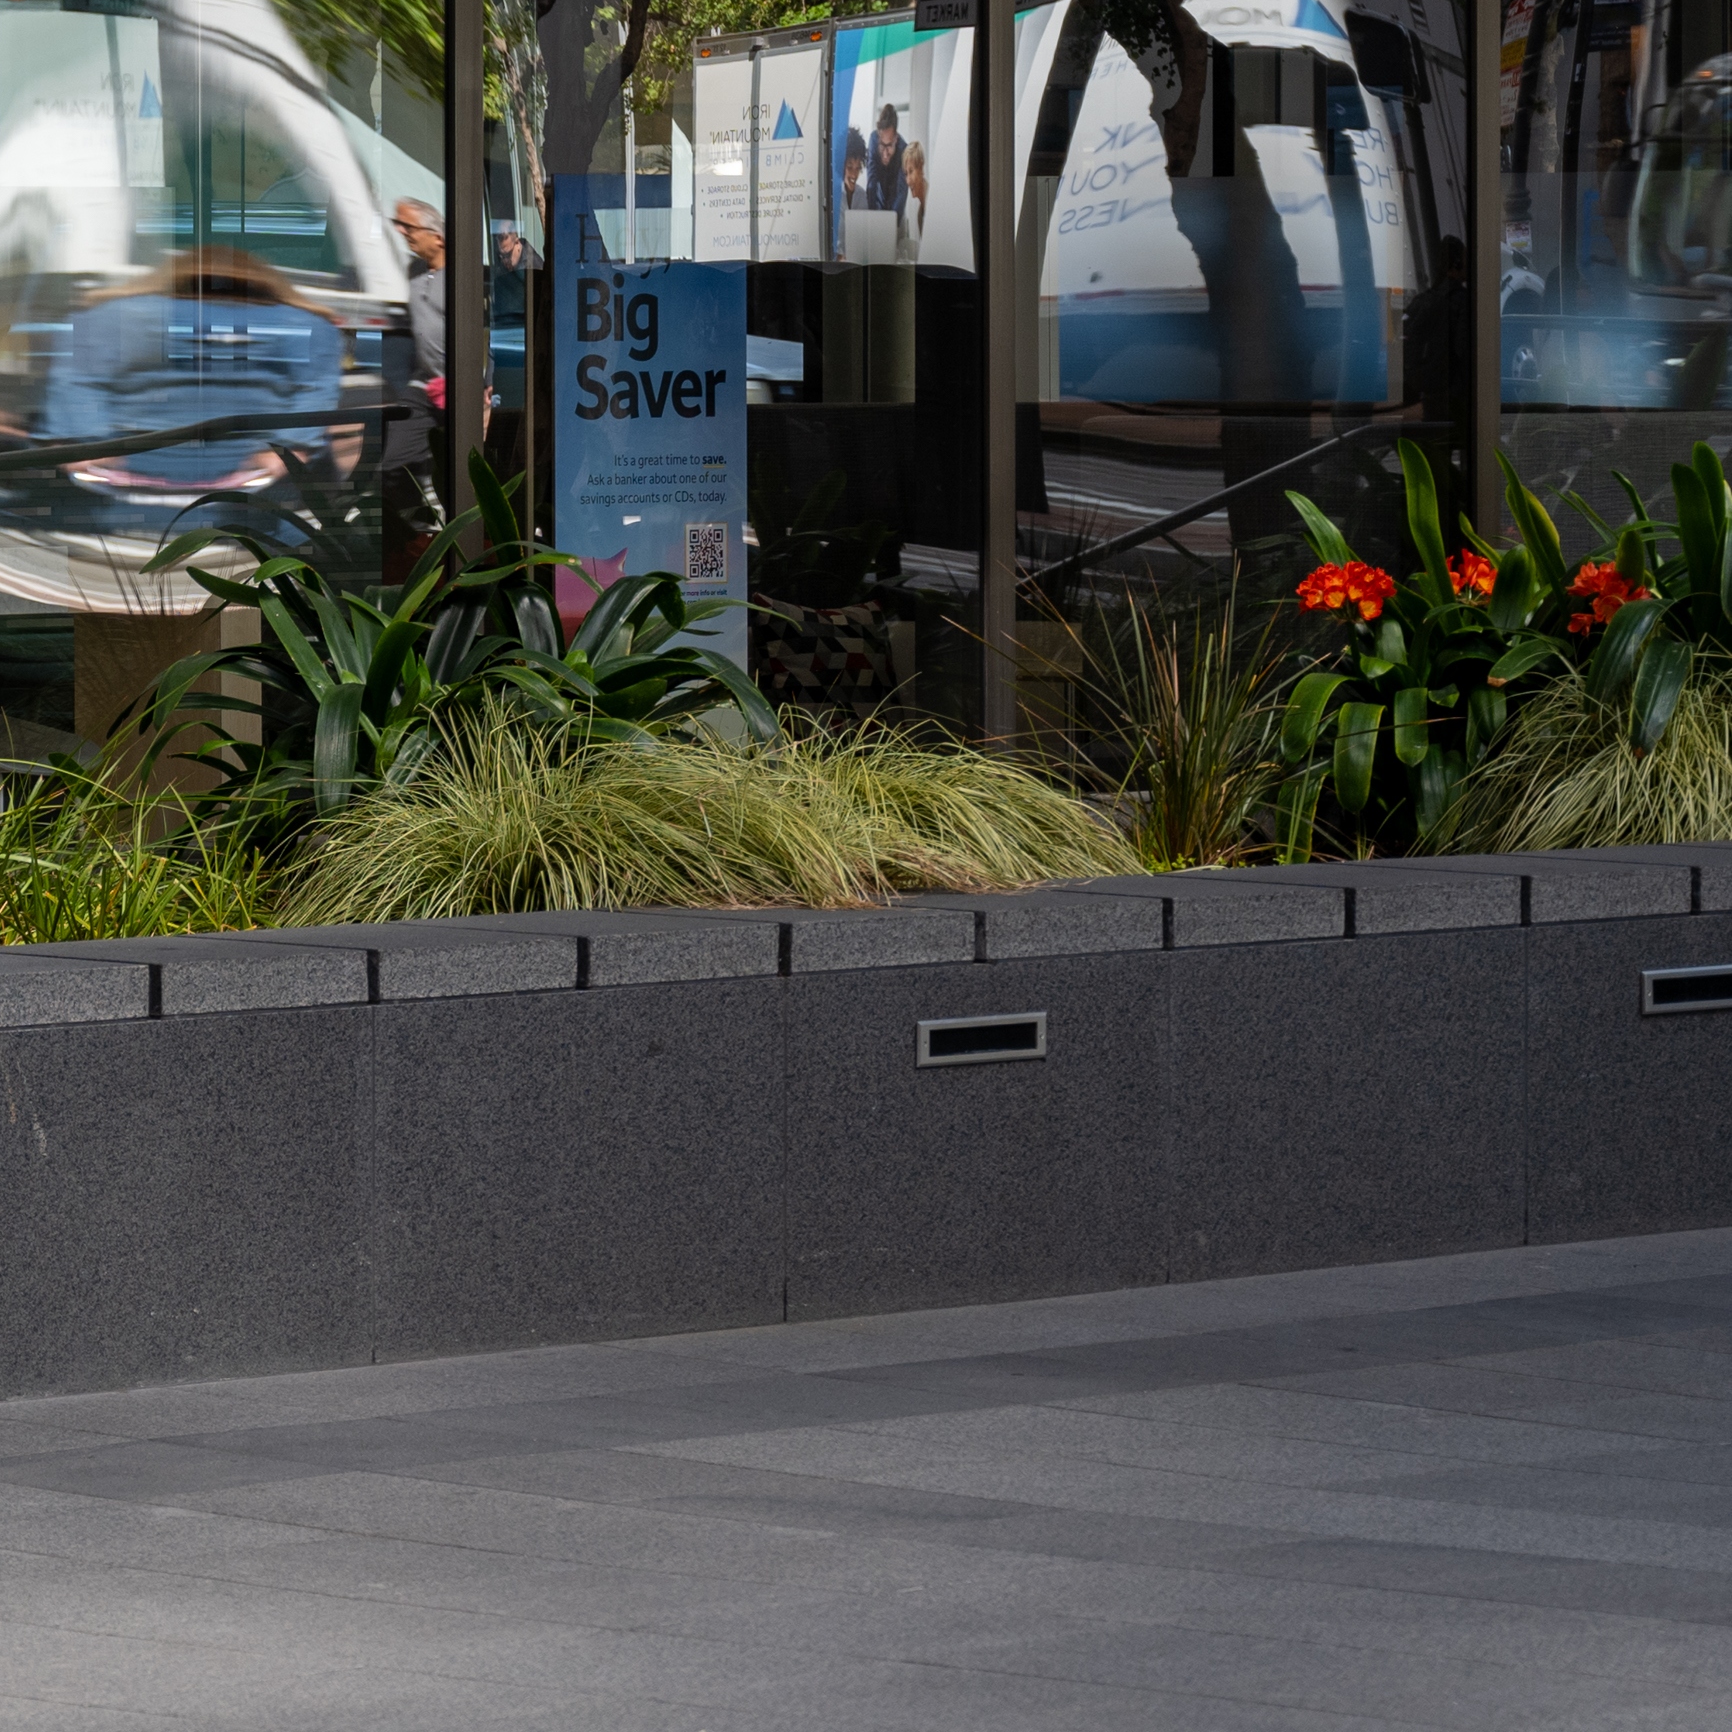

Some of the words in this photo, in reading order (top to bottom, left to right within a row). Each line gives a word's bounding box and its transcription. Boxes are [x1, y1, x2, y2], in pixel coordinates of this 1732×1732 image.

[577, 273, 659, 362] Big
[574, 353, 727, 420] Saver
[630, 457, 636, 466] a
[638, 455, 663, 469] great
[665, 453, 688, 465] time
[689, 455, 701, 465] to
[702, 454, 727, 465] save.
[587, 474, 605, 486] Ask
[606, 476, 613, 485] a
[615, 473, 647, 485] banker
[649, 472, 677, 485] about
[679, 474, 697, 484] one
[698, 471, 709, 483] of
[711, 473, 727, 483] our
[580, 493, 616, 507] savings
[617, 492, 661, 504] accounts
[662, 493, 672, 503] or
[674, 491, 697, 504] CDs,
[698, 490, 727, 505] today.
